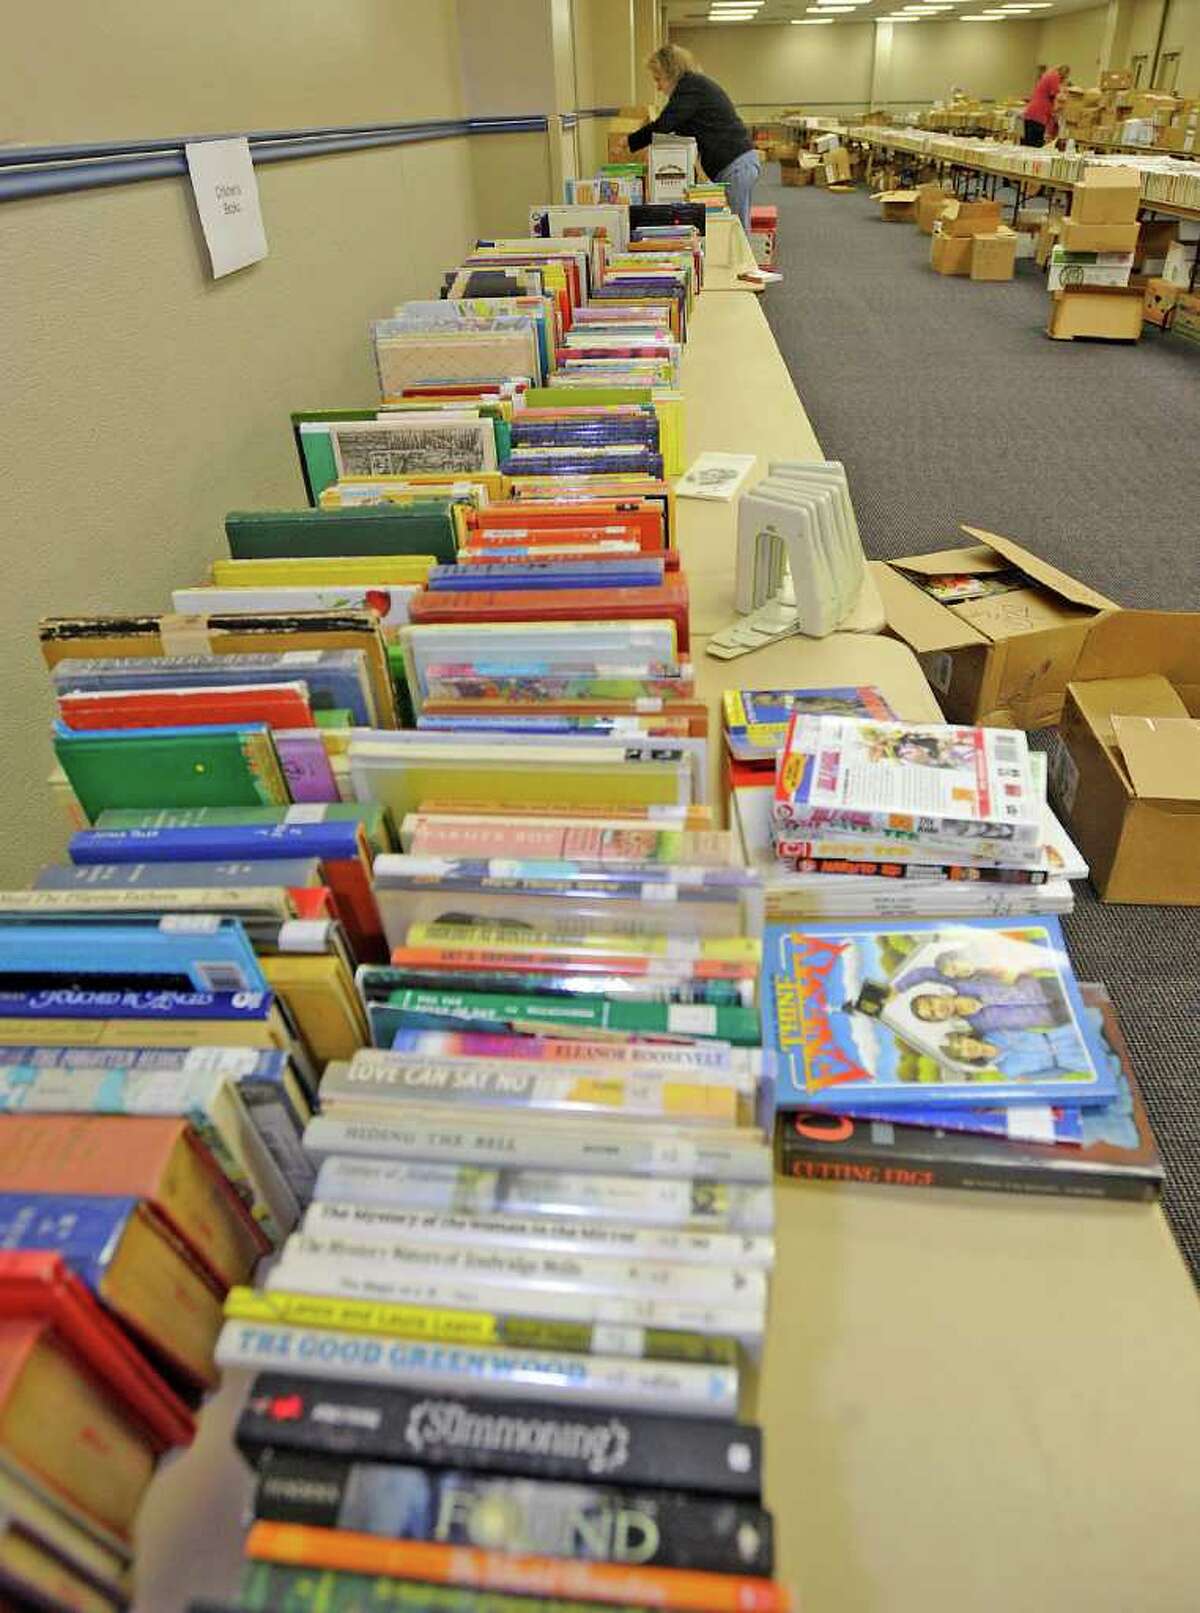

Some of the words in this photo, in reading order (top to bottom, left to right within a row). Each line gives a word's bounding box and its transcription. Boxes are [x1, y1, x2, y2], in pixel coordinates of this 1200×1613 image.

[555, 1043, 626, 1062] ELEANOR
[631, 1047, 723, 1067] ROOSEVELT
[348, 1062, 403, 1086] LOVE
[404, 1065, 447, 1089] CAN
[451, 1070, 490, 1090] SAY
[494, 1073, 529, 1092] NO
[427, 1132, 463, 1147] THE
[792, 1159, 880, 1184] CUTTING
[884, 1166, 935, 1186] EDGE
[322, 1204, 349, 1219] The
[354, 1207, 417, 1228] Mystery
[420, 1214, 439, 1228] of
[440, 1215, 467, 1230] the
[549, 1221, 577, 1238] the
[239, 1326, 291, 1352] THE
[297, 1334, 382, 1364] GOOD
[389, 1341, 588, 1384] GREENWOOD
[434, 1484, 660, 1565] FOND
